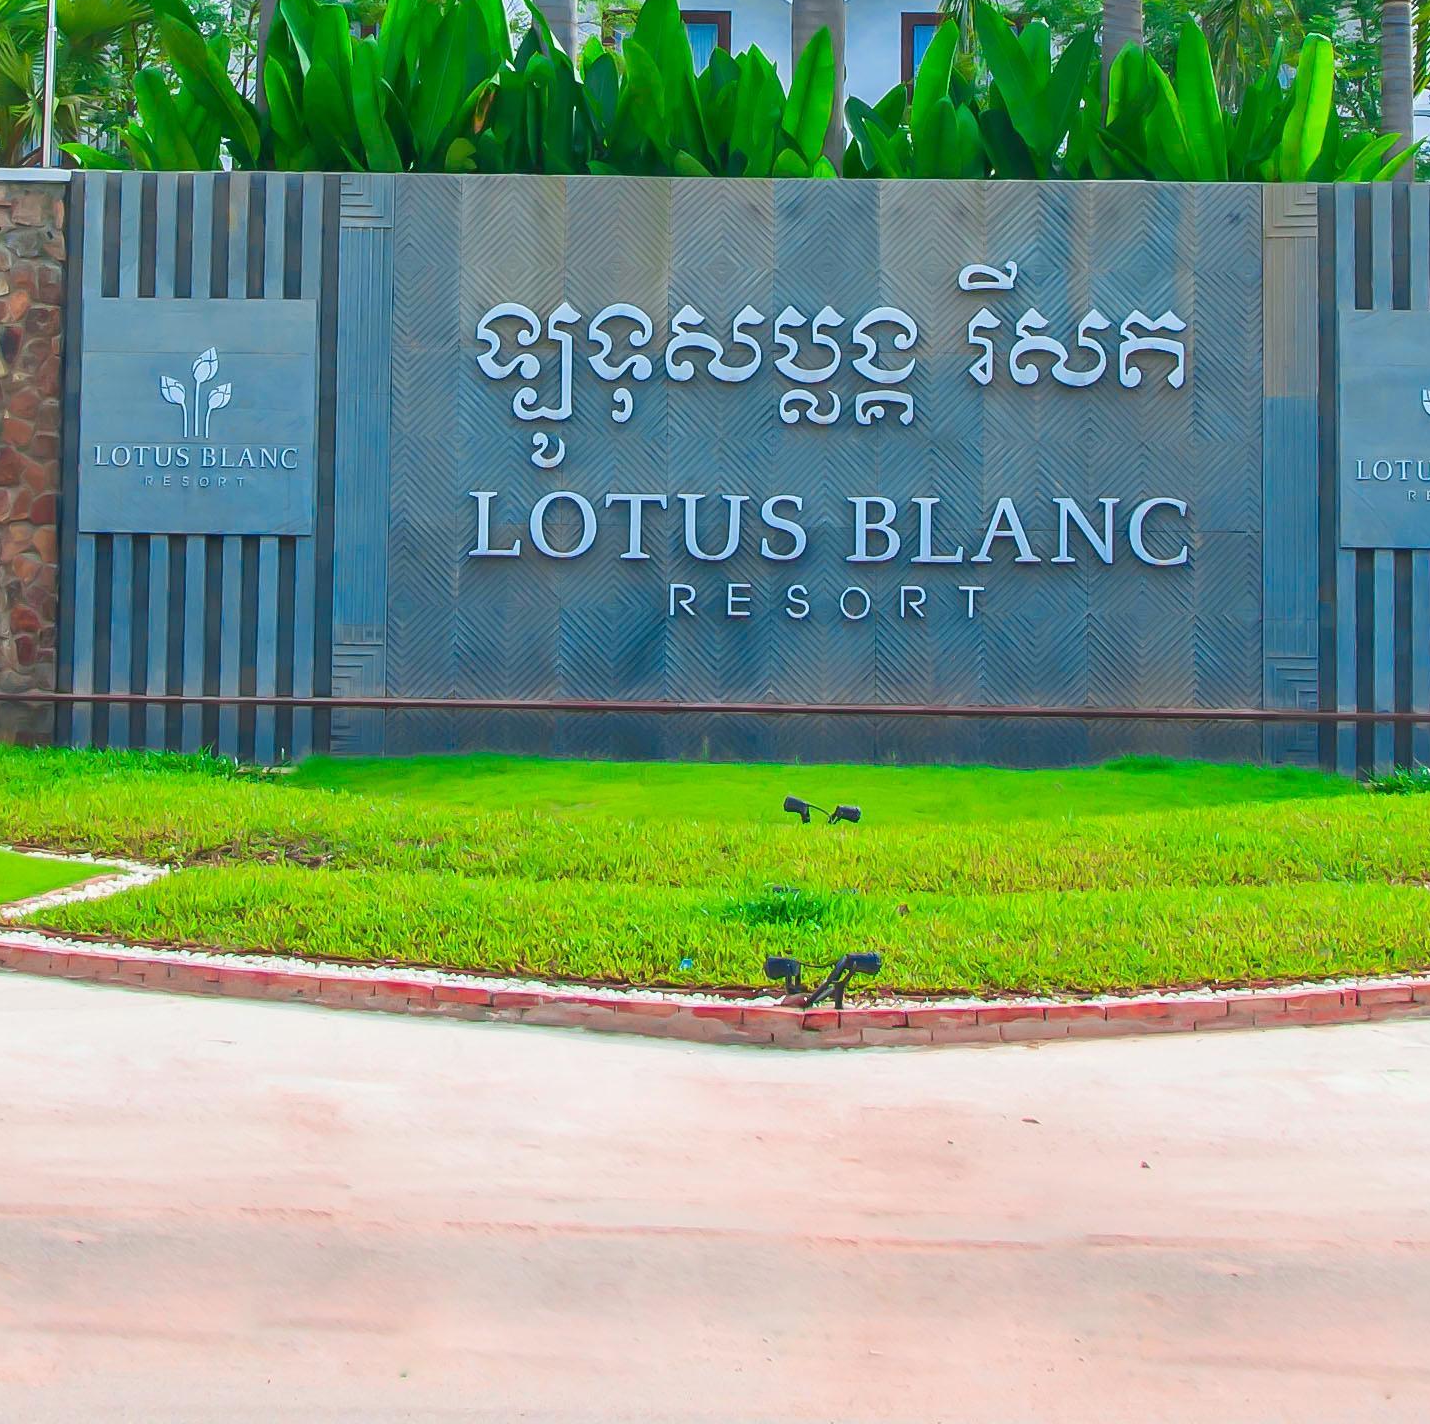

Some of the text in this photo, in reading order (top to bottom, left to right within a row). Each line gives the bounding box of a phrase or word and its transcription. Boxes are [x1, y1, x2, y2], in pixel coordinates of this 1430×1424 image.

[958, 261, 1187, 389] រីសត
[94, 444, 299, 469] LOTUS BLANC
[145, 475, 246, 487] RESORT
[468, 490, 1189, 567] LOTUS BLANC
[669, 583, 985, 621] RESORT
